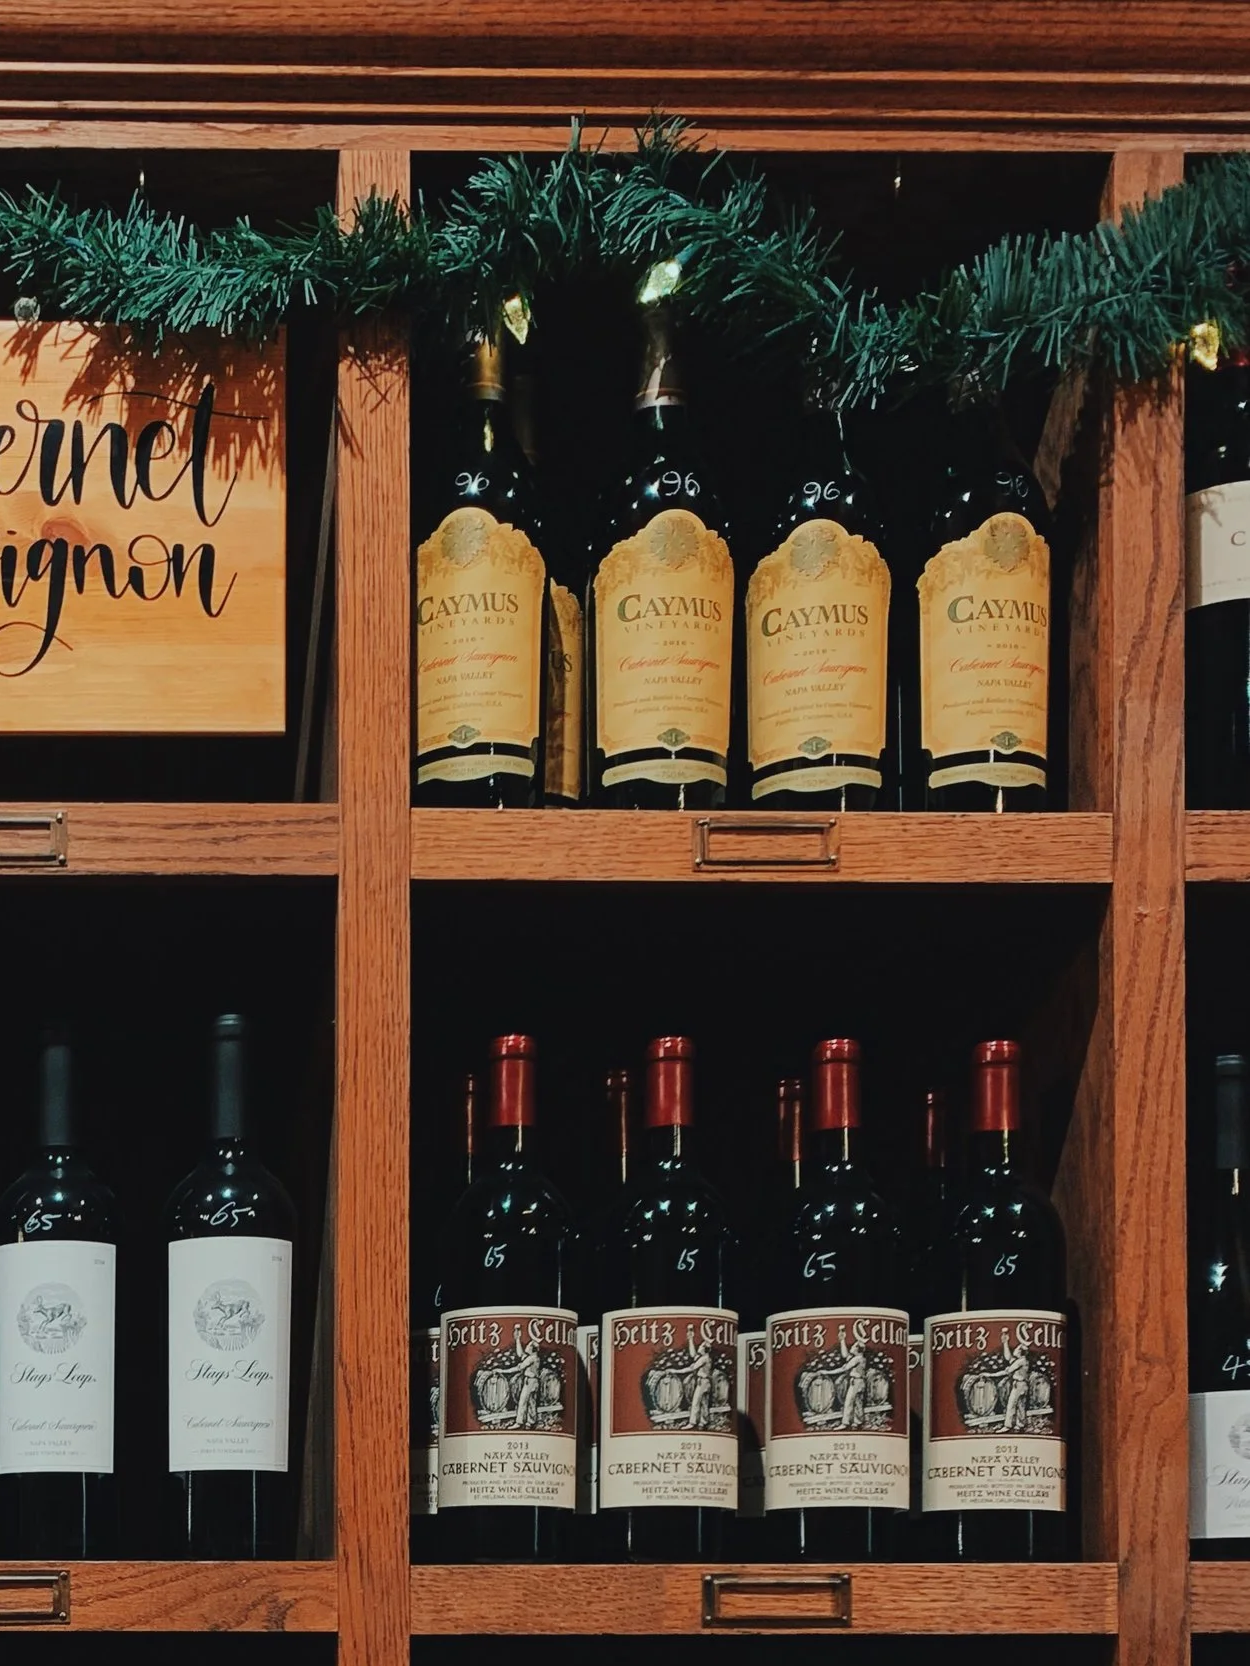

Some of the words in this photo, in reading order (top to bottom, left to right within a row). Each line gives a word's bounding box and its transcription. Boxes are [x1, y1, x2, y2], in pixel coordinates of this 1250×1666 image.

[454, 471, 490, 496] 96
[661, 471, 701, 497] 96
[803, 480, 841, 503] 96
[417, 593, 519, 626] CAYMUS
[617, 594, 722, 622] CAYMUS
[948, 595, 1048, 627] CAYMUS
[761, 604, 868, 638] CAYMUS
[24, 1211, 59, 1232] 65
[210, 1202, 250, 1227] 65
[484, 1244, 507, 1269] 65
[677, 1248, 699, 1271] 65
[803, 1252, 836, 1281] 65
[993, 1253, 1018, 1276] 65
[484, 1452, 513, 1461] NAPA
[515, 1452, 550, 1461] VALLEY
[442, 1463, 506, 1477] CABERNET
[608, 1463, 679, 1476] CABERNET
[768, 1463, 833, 1478] CABERNET
[927, 1466, 995, 1481] CABERNET
[469, 1486, 495, 1495] HEITZ
[498, 1486, 518, 1495] WINE
[522, 1486, 559, 1495] CELLARS
